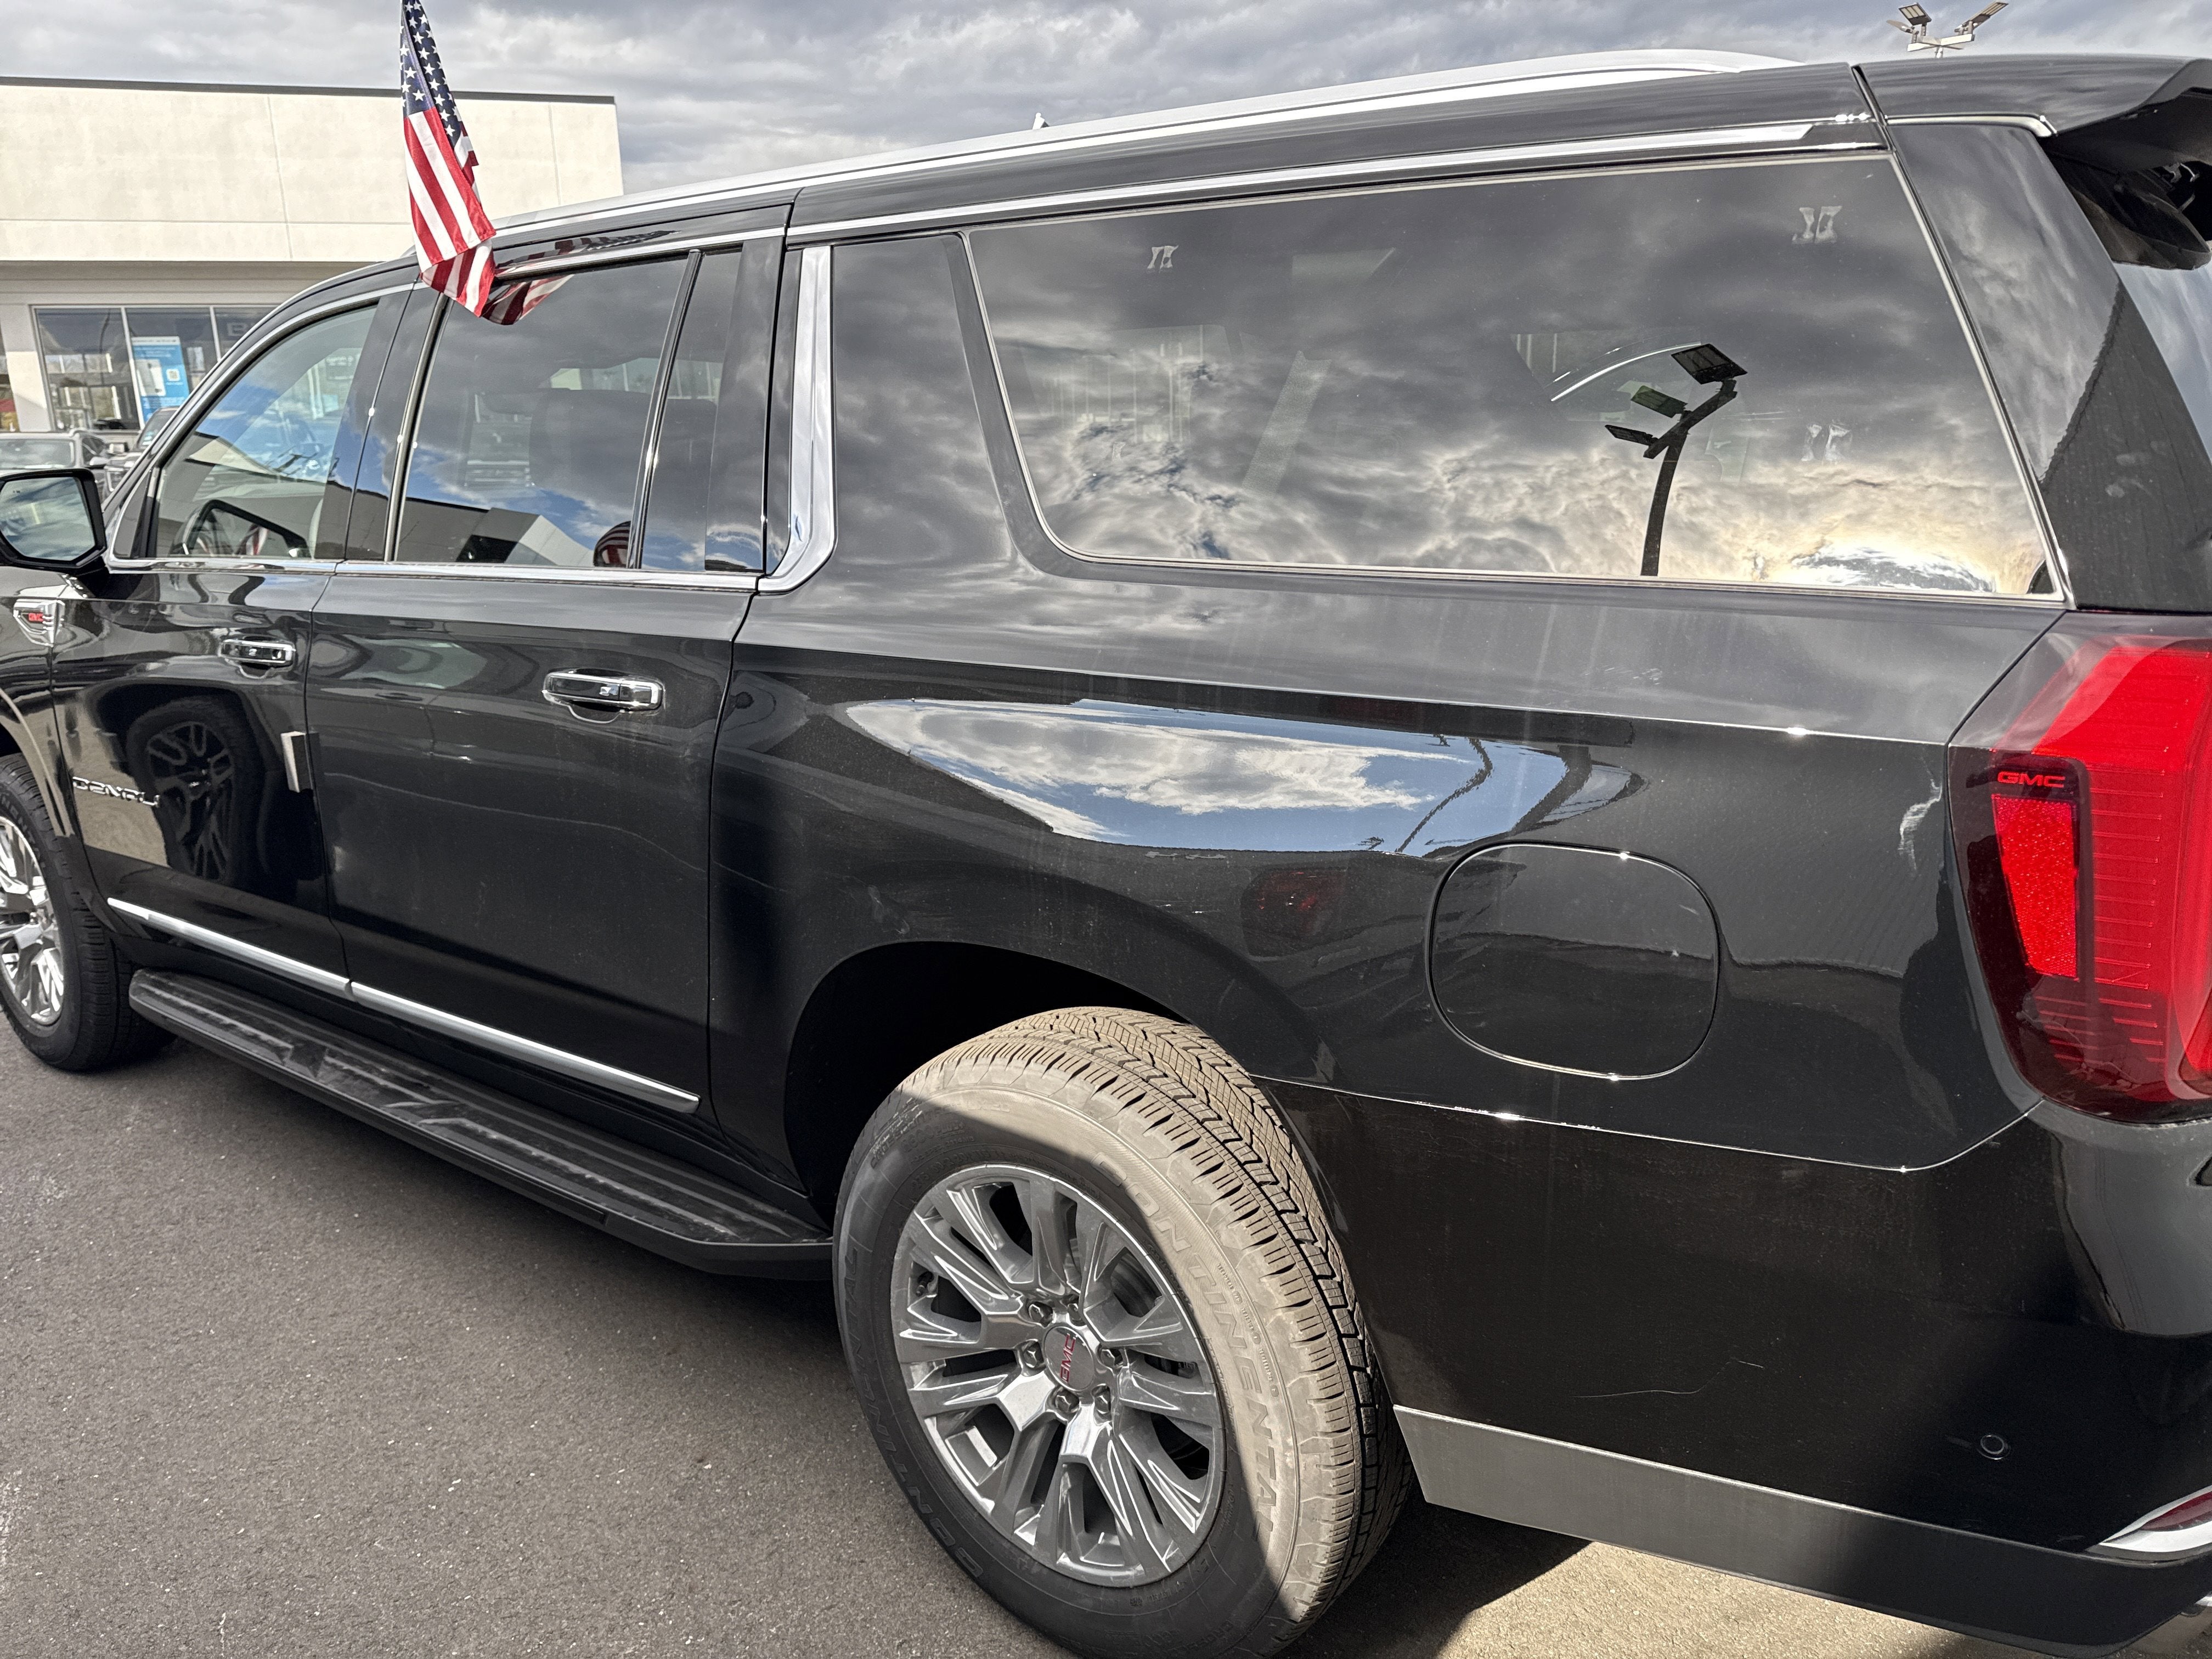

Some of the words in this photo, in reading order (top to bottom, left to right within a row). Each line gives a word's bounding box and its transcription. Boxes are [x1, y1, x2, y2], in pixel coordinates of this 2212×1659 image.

[72, 776, 161, 808] DENALI
[1997, 771, 2066, 788] GMC
[1060, 1333, 1076, 1383] GMC
[1090, 1152, 1276, 1541] CONTINENTAL
